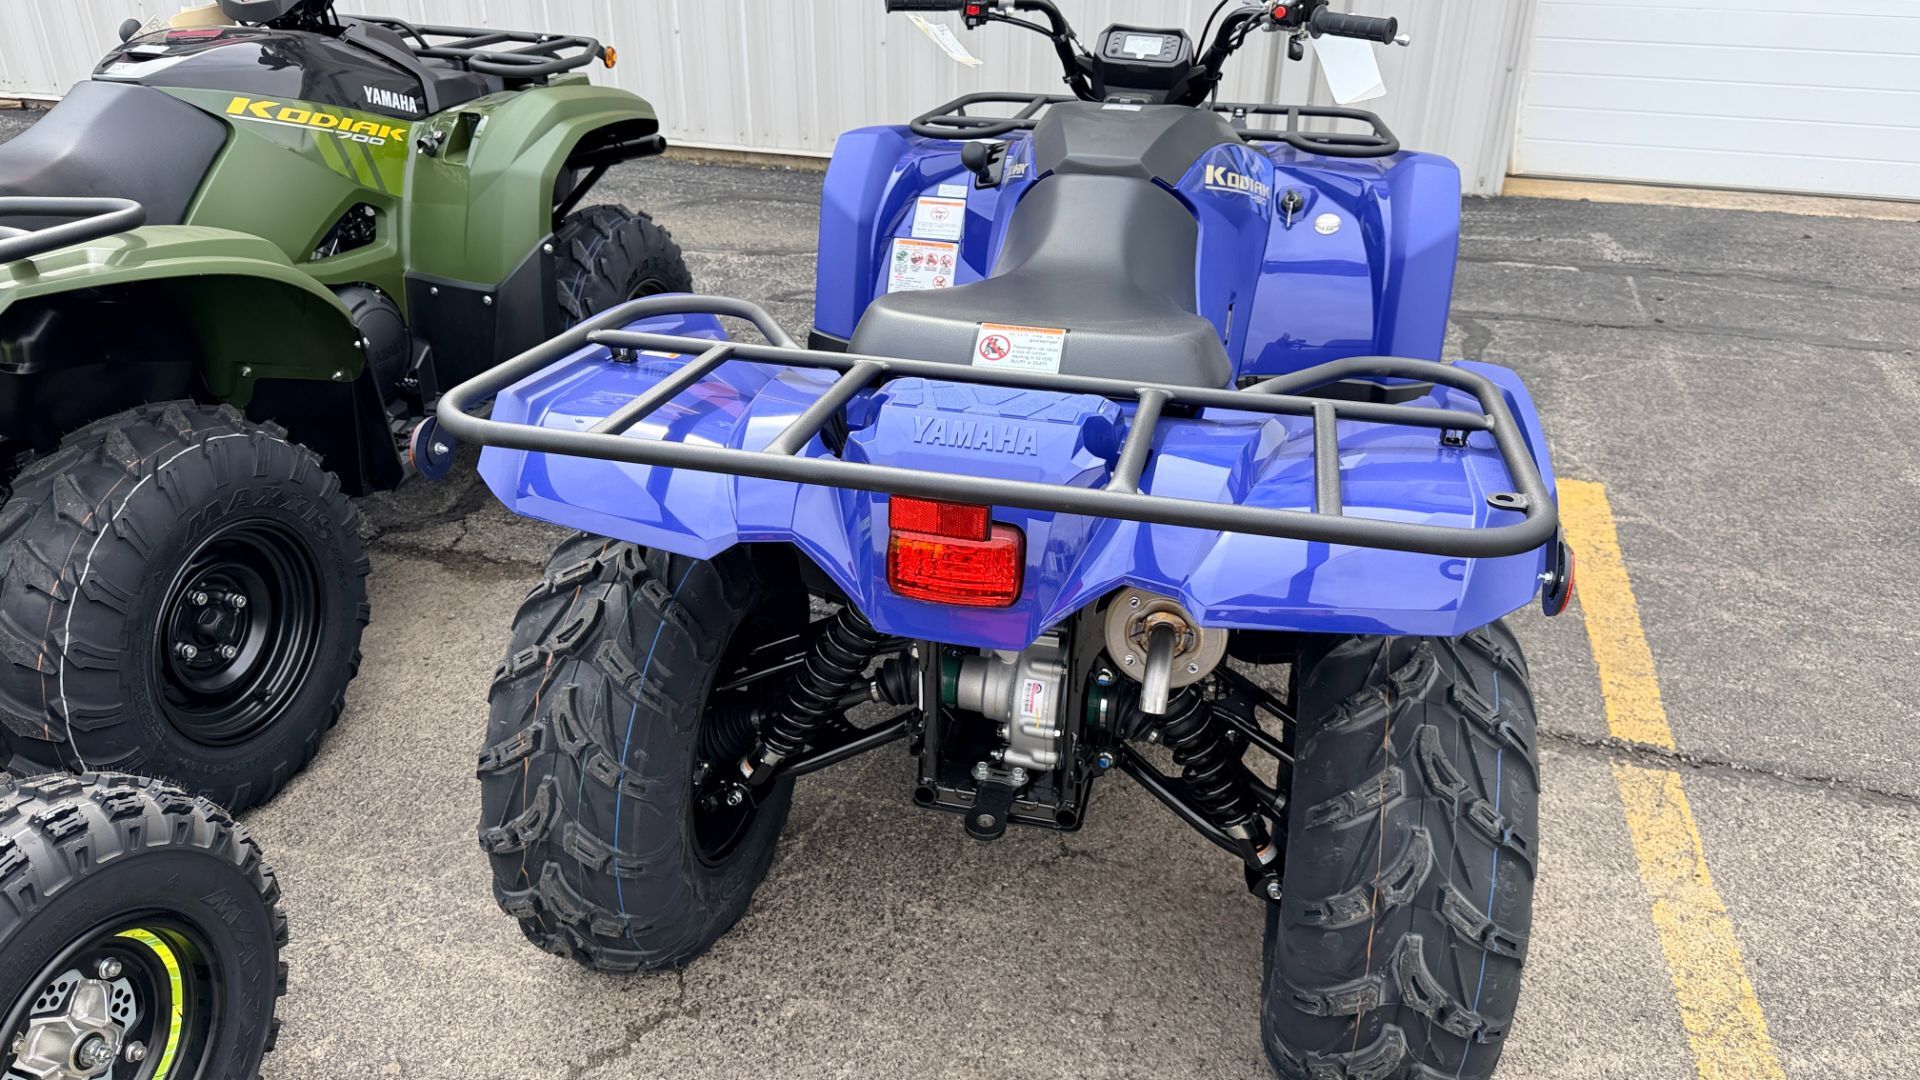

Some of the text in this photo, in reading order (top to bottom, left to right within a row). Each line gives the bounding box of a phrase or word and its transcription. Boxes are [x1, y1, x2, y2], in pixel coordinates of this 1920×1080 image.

[363, 85, 418, 114] YAMAHA
[225, 96, 407, 142] KODIAK
[336, 131, 386, 146] 700
[1204, 164, 1270, 200] KODIAK
[913, 415, 1038, 457] YAMAHA
